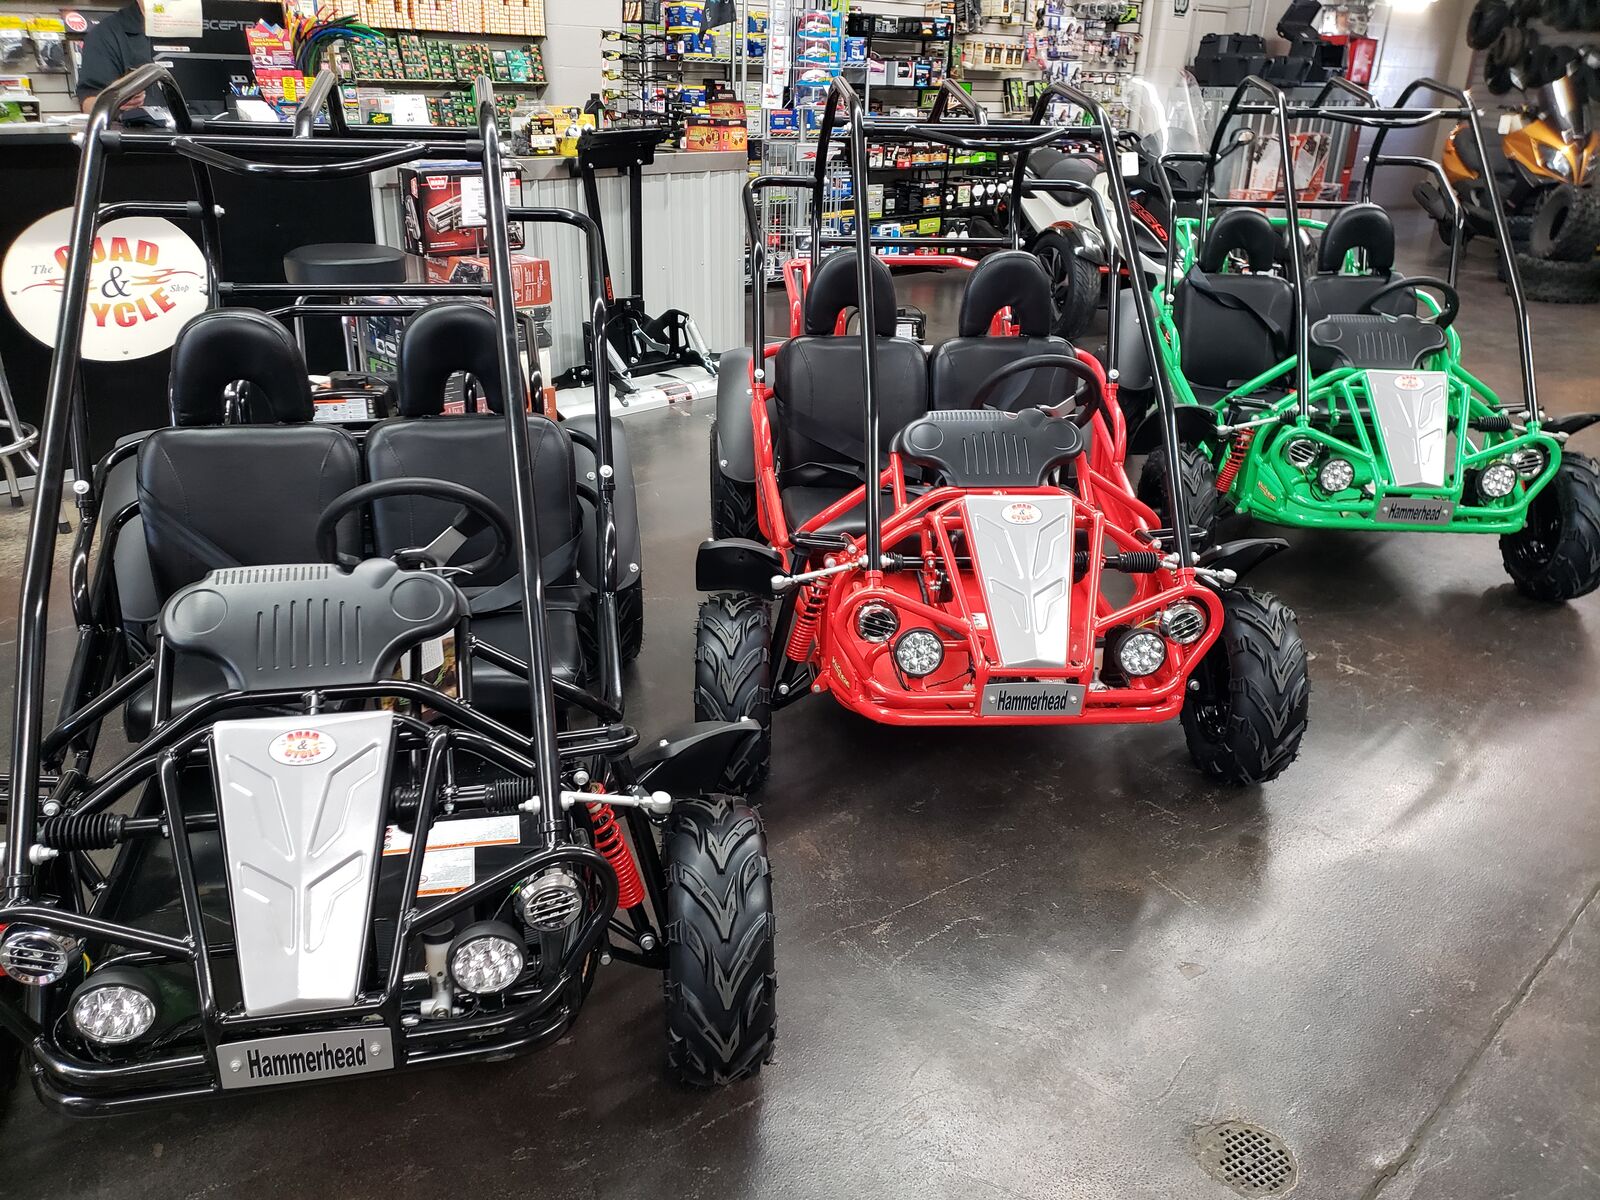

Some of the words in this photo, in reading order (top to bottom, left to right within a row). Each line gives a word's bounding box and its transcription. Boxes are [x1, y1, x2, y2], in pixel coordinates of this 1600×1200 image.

[31, 265, 54, 275] The
[101, 265, 133, 298] &
[170, 284, 190, 294] Shop
[89, 287, 177, 328] YCLE
[1388, 503, 1442, 520] Hammerhead
[997, 690, 1068, 711] Hammerhead
[287, 731, 319, 741] QUAD
[284, 748, 321, 758] CYCLE
[246, 1039, 367, 1079] Hammerhead
